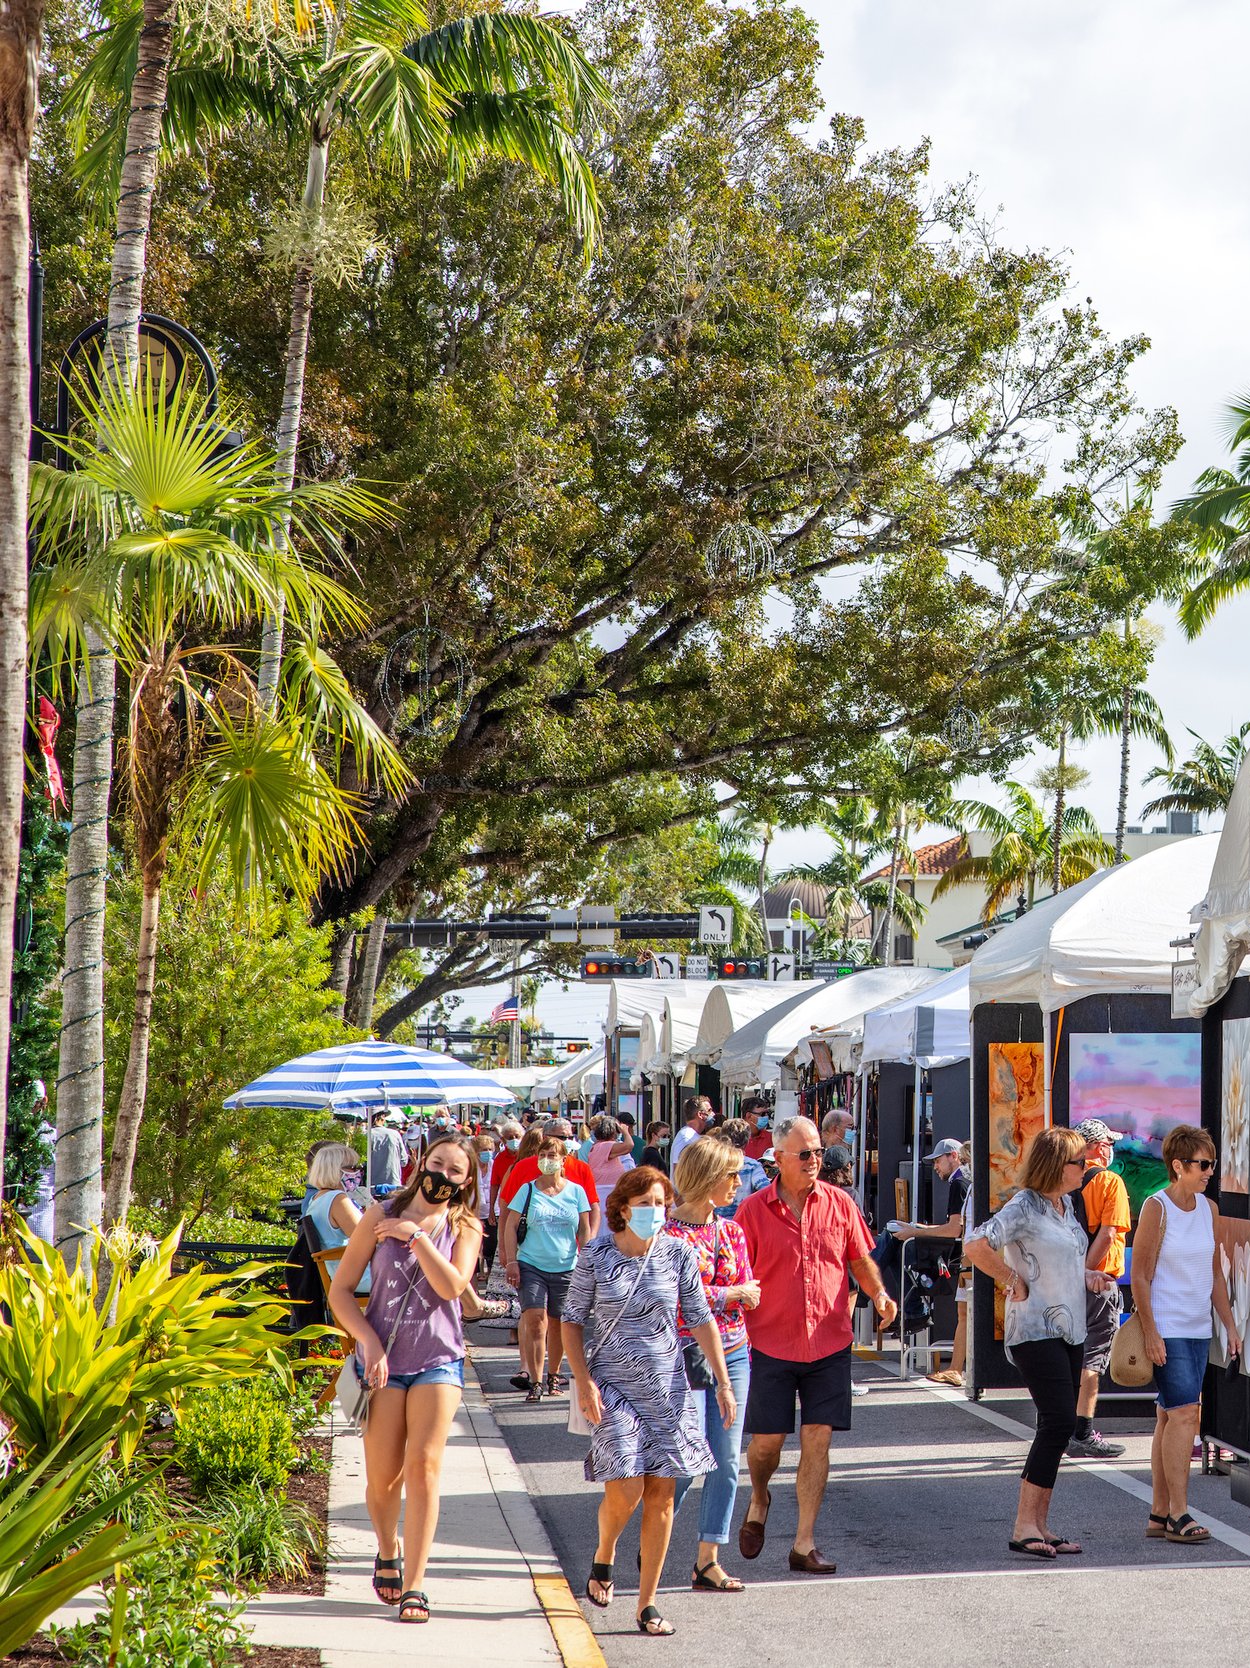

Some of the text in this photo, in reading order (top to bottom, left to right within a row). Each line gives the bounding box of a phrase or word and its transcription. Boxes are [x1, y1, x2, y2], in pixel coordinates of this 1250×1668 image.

[703, 933, 727, 941] ONLY
[386, 1279, 398, 1289] W
[406, 1306, 413, 1316] S
